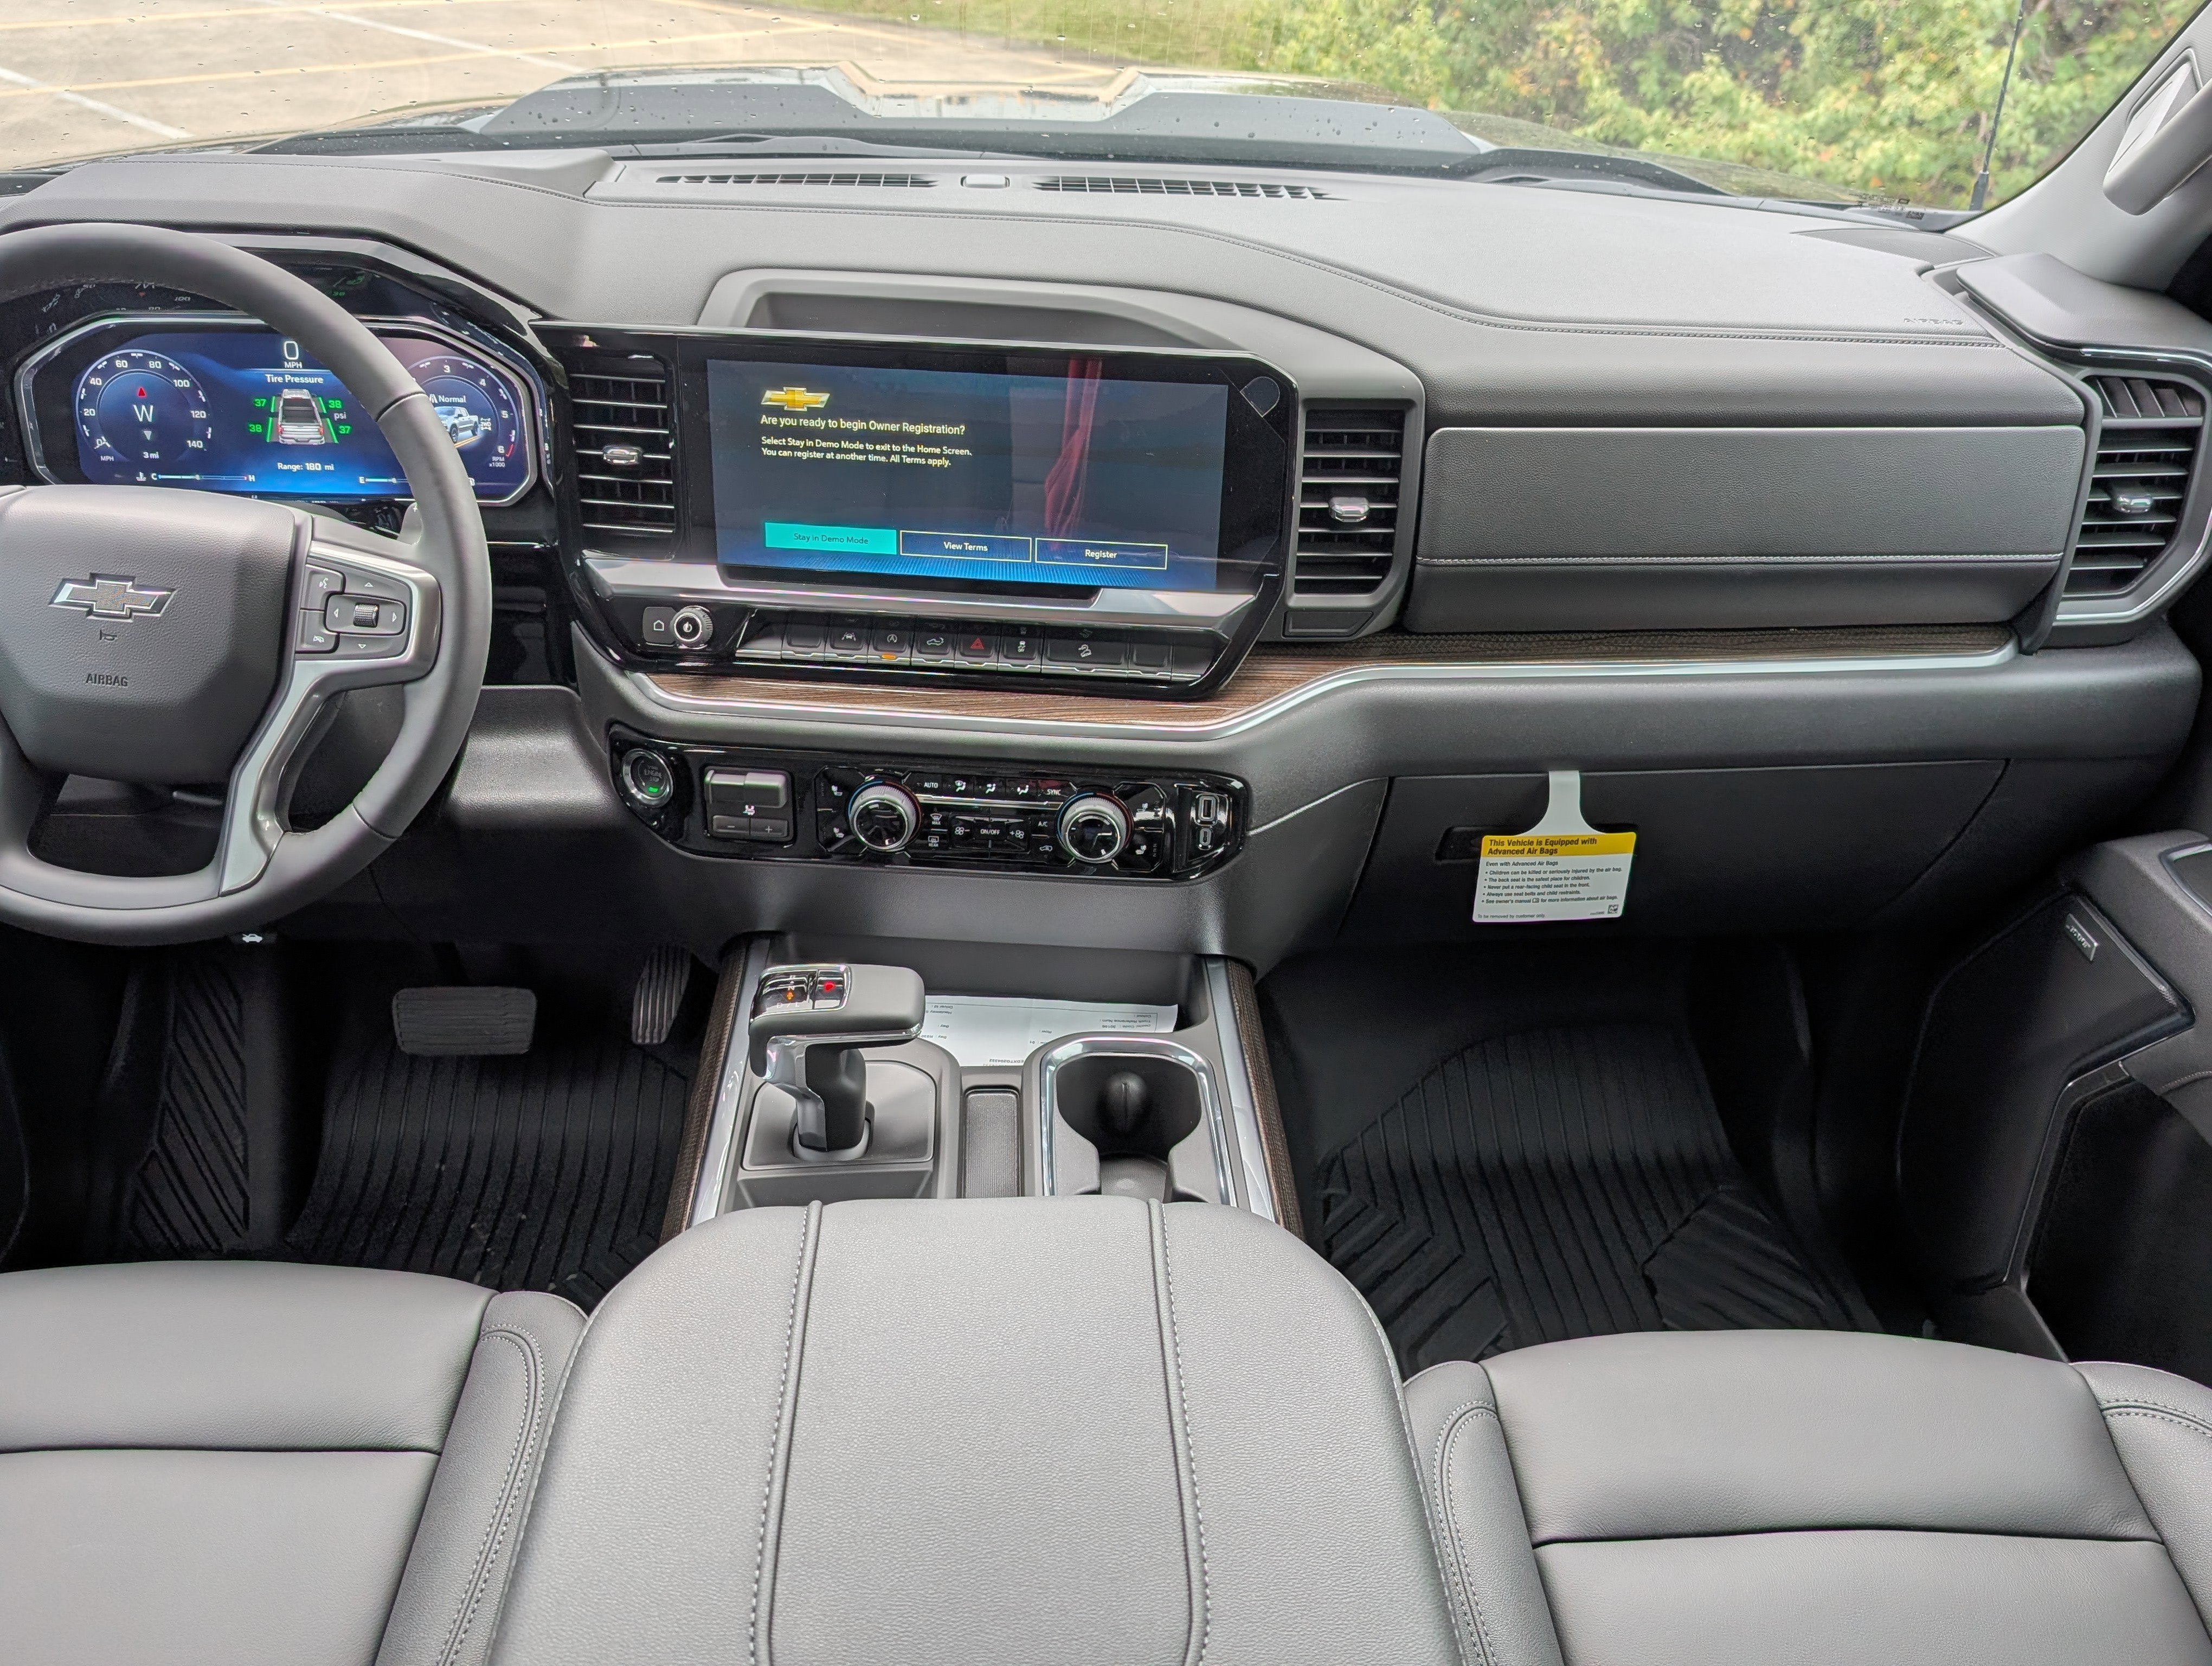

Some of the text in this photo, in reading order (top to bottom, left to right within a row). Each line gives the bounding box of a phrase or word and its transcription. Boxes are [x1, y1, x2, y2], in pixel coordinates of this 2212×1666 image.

[284, 340, 299, 360] 0
[115, 360, 128, 368] 60
[89, 377, 102, 386] 40
[265, 374, 324, 384] Tire Pressure
[479, 379, 486, 387] 4
[254, 398, 267, 407] 37
[439, 395, 466, 403] Normal
[329, 400, 342, 409] 38
[83, 408, 96, 416] 20
[132, 405, 153, 422] W
[334, 412, 347, 421] psi
[501, 410, 508, 419] 5
[249, 424, 262, 432] 38
[760, 415, 966, 435] Are you ready to begin Owner Registration?
[339, 426, 351, 434] 37
[186, 440, 203, 448] 140
[761, 436, 786, 446] Select
[787, 437, 805, 448] Stay
[806, 439, 814, 447] in
[815, 439, 840, 448] Demo
[841, 440, 865, 450] Mode
[875, 443, 891, 451] exit
[892, 444, 901, 452] to
[902, 444, 916, 452] the
[917, 444, 941, 454] Home
[942, 446, 972, 456] Screen.
[497, 445, 505, 453] 6
[761, 447, 777, 456] You
[794, 450, 825, 459] register
[825, 451, 834, 459] at
[835, 452, 866, 461] another
[867, 453, 889, 463] time.
[889, 454, 901, 463] All
[901, 454, 926, 464] Terms
[927, 457, 951, 468] apply.
[278, 463, 304, 472] Range:
[305, 463, 321, 471] 180
[793, 533, 869, 544] Stay in Demo Mode
[943, 541, 988, 552] View Terms
[1084, 549, 1118, 560] Register
[85, 673, 128, 688] AIRBAG
[1545, 838, 1579, 847] Equipped
[1539, 847, 1558, 856] Bags
